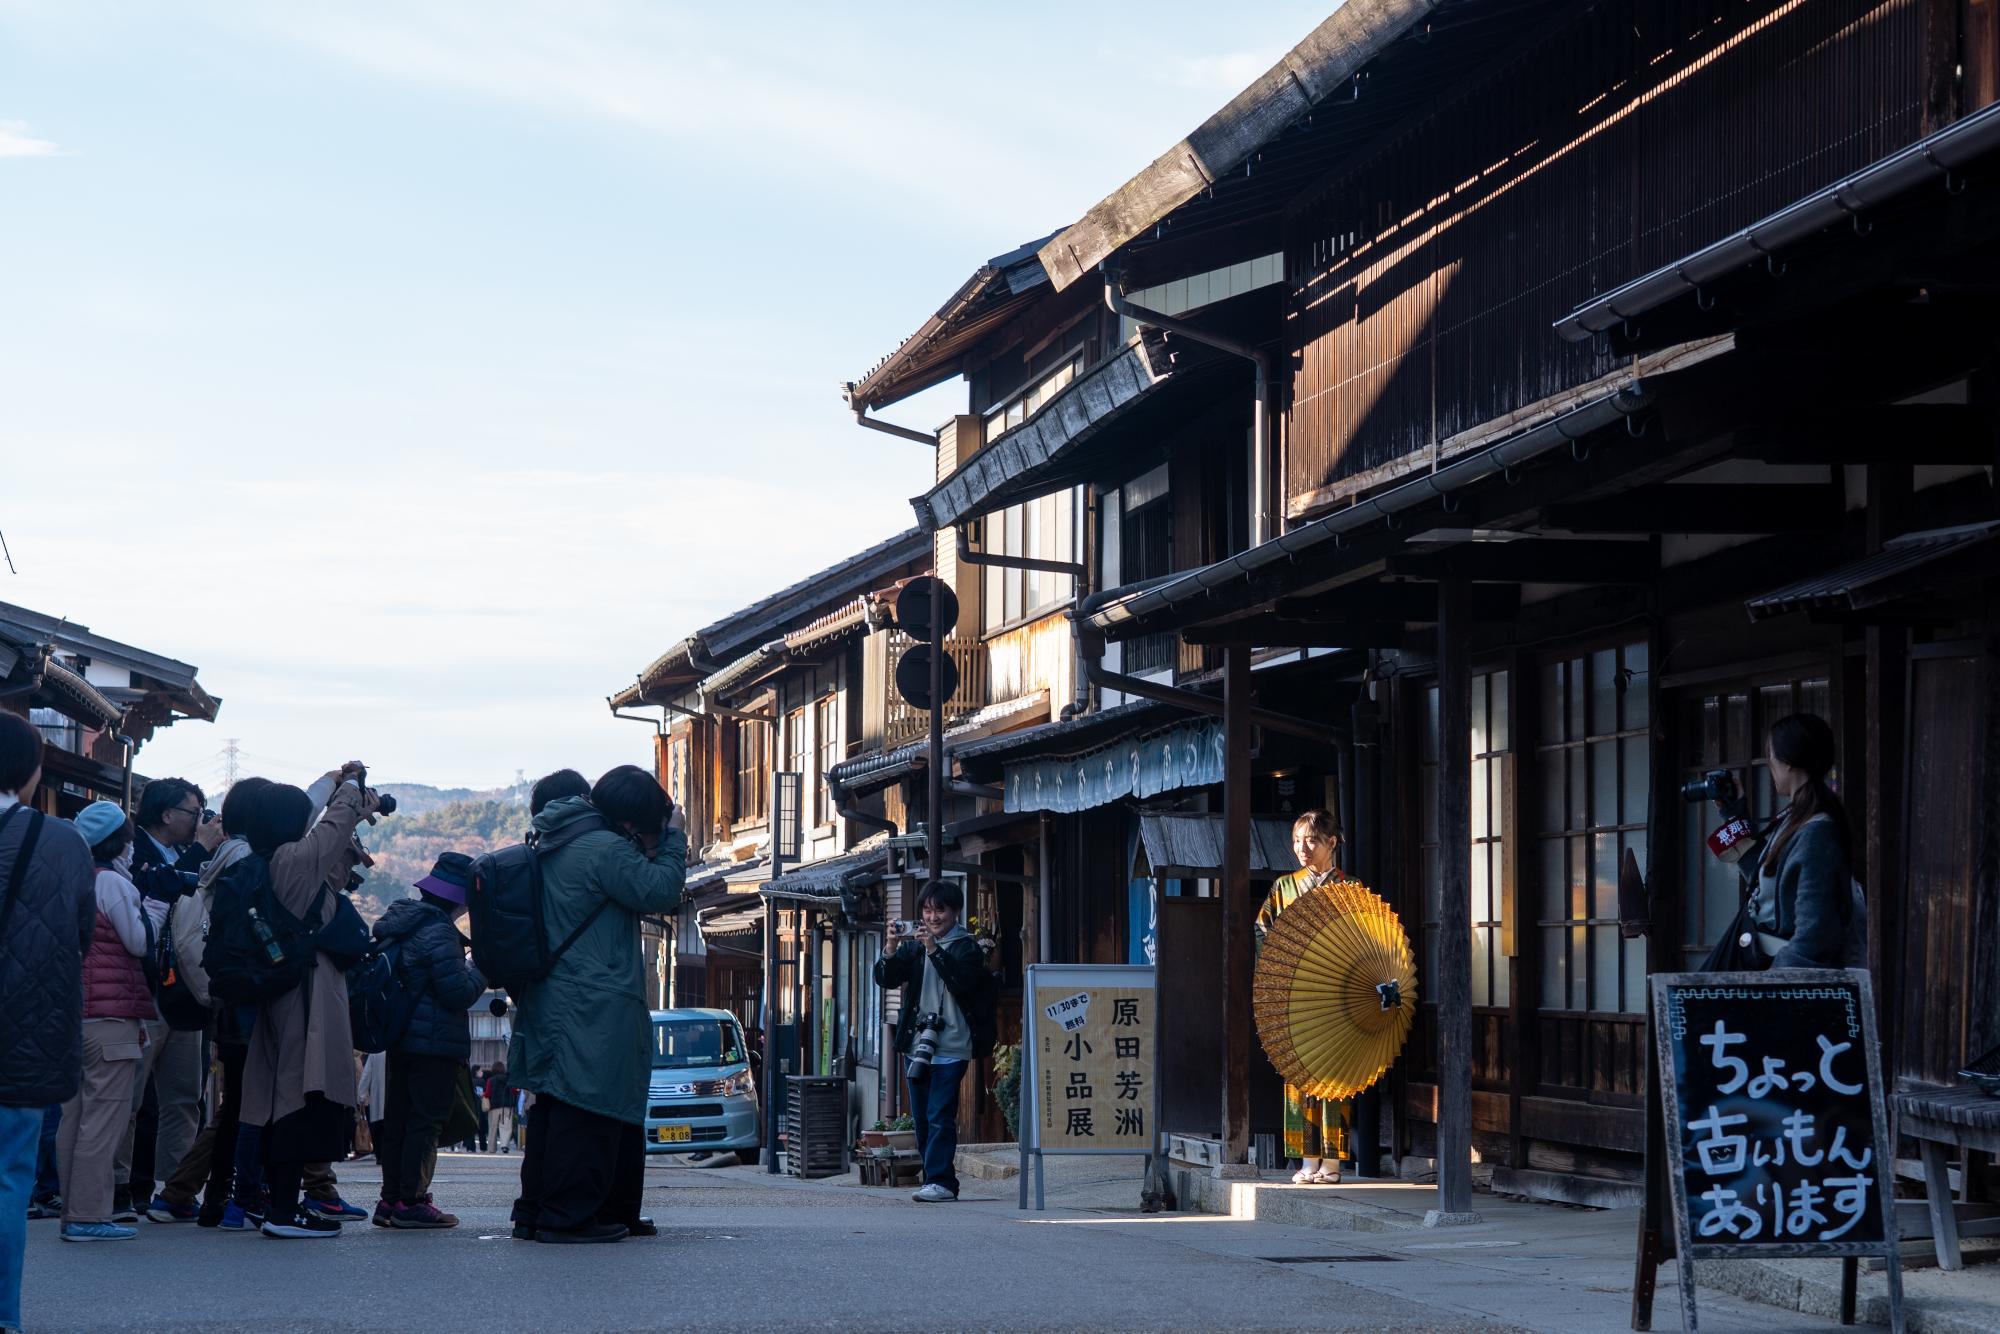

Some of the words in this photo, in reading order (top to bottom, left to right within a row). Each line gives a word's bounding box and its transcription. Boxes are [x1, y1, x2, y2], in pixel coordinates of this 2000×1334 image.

[1047, 994, 1088, 1017] 11/30まで
[1065, 1015, 1085, 1030] 無料
[1064, 1033, 1095, 1137] 小品展
[1112, 998, 1144, 1136] 原田芳洲
[1699, 1019, 1863, 1099] ちょっと
[1687, 1105, 1872, 1176] 古いもん
[1699, 1173, 1874, 1240] あります
